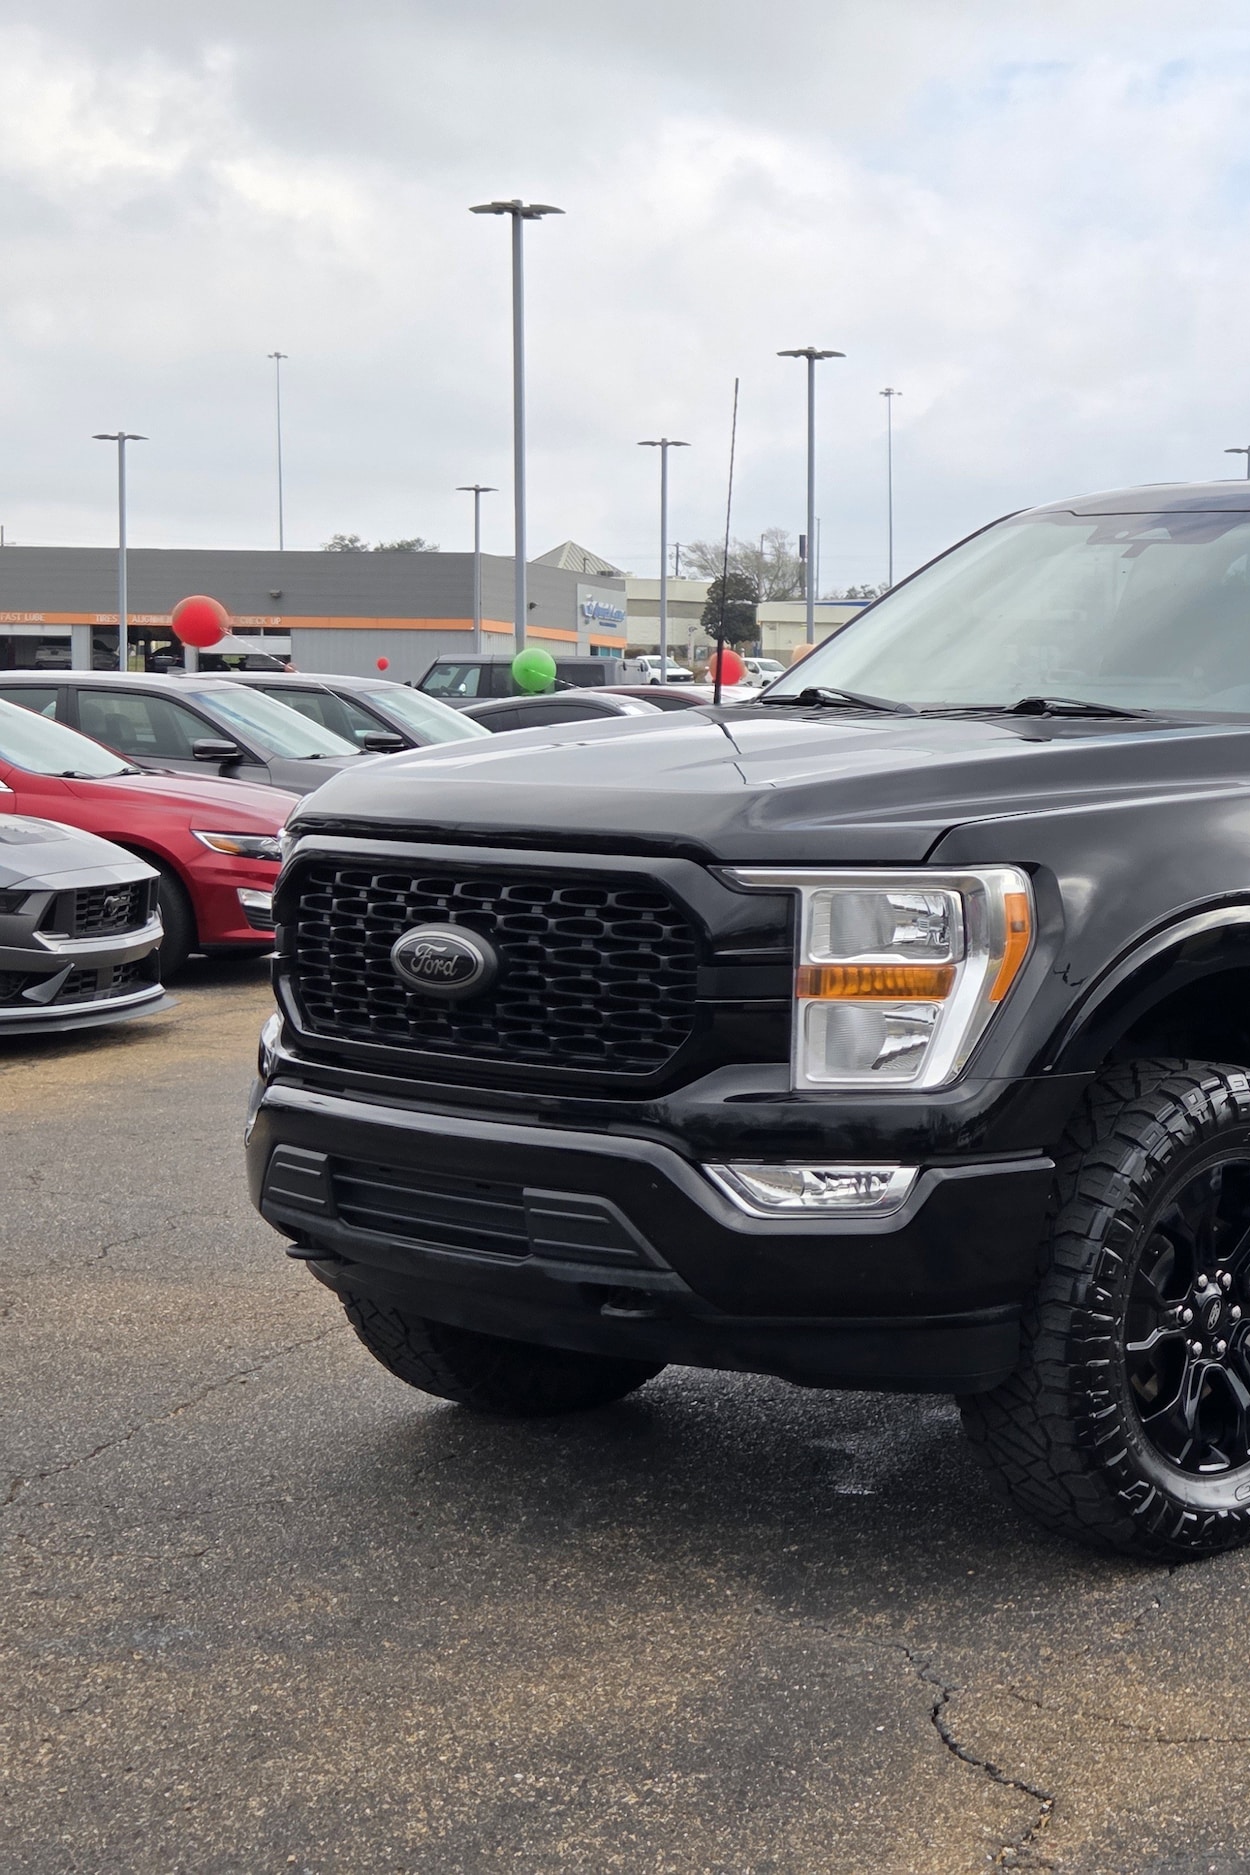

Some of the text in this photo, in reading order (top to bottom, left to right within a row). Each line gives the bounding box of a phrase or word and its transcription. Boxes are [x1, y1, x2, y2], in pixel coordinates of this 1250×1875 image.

[0, 612, 45, 621] FAST LUBE
[95, 614, 118, 623] TIRES
[270, 616, 281, 625] UP
[411, 943, 459, 976] Ford
